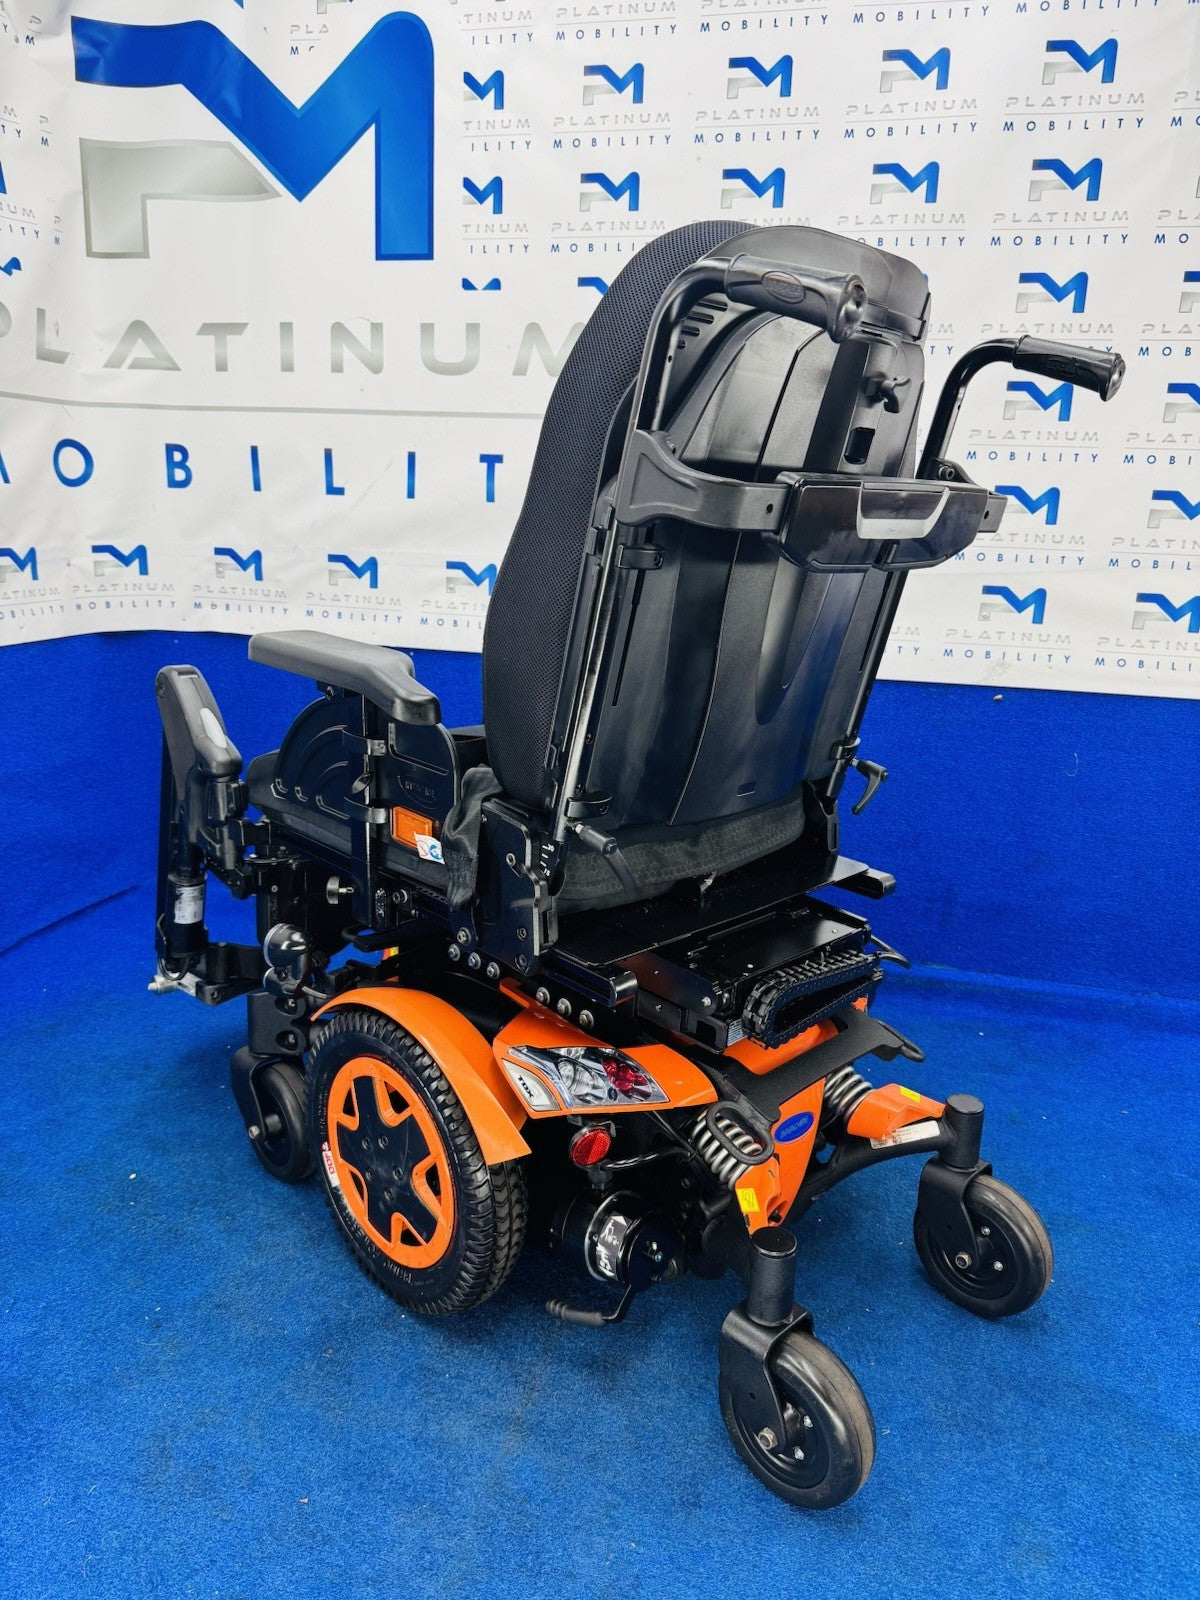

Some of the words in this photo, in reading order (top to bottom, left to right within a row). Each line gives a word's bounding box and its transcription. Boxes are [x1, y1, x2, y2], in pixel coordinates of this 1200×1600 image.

[458, 10, 533, 24] TINUM
[555, 2, 676, 19] PLATINUM
[853, 6, 989, 24] MOBILITY
[700, 15, 828, 32] MOBILITY
[556, 24, 677, 41] MOBILITY
[845, 98, 978, 116] PLATINUM
[1005, 92, 1145, 109] PLATINUM
[553, 112, 671, 127] PLATINUM
[695, 106, 820, 122] PLATINUM
[844, 121, 978, 139] MOBILITY
[1002, 117, 1144, 132] MOBILITY
[553, 135, 671, 149] MOBILITY
[694, 130, 820, 144] MOBILITY
[837, 212, 966, 226] PLATINUM
[992, 210, 1129, 224] PLATINUM
[551, 219, 666, 232] PLATINUM
[551, 242, 649, 253] MOBILI
[990, 234, 1129, 247] MOBILITY
[980, 323, 1114, 334] PLATINUM
[968, 429, 1099, 442] PLATINUM
[966, 450, 1099, 463] MOBILITY
[0, 438, 504, 503] OBILIT
[975, 532, 1085, 545] ATINUM
[955, 552, 1085, 566] MOBILITY
[72, 582, 175, 594] PLATINUM
[192, 585, 287, 599] PLATINUM
[76, 600, 176, 611] MOBILITY
[306, 591, 402, 607] PLATINUM
[194, 602, 289, 616] MOBILITY
[306, 609, 403, 624] MOBILITY
[946, 629, 1072, 645] PLATINUM
[943, 648, 1072, 665] MOBILITY
[516, 1075, 535, 1099] TDX
